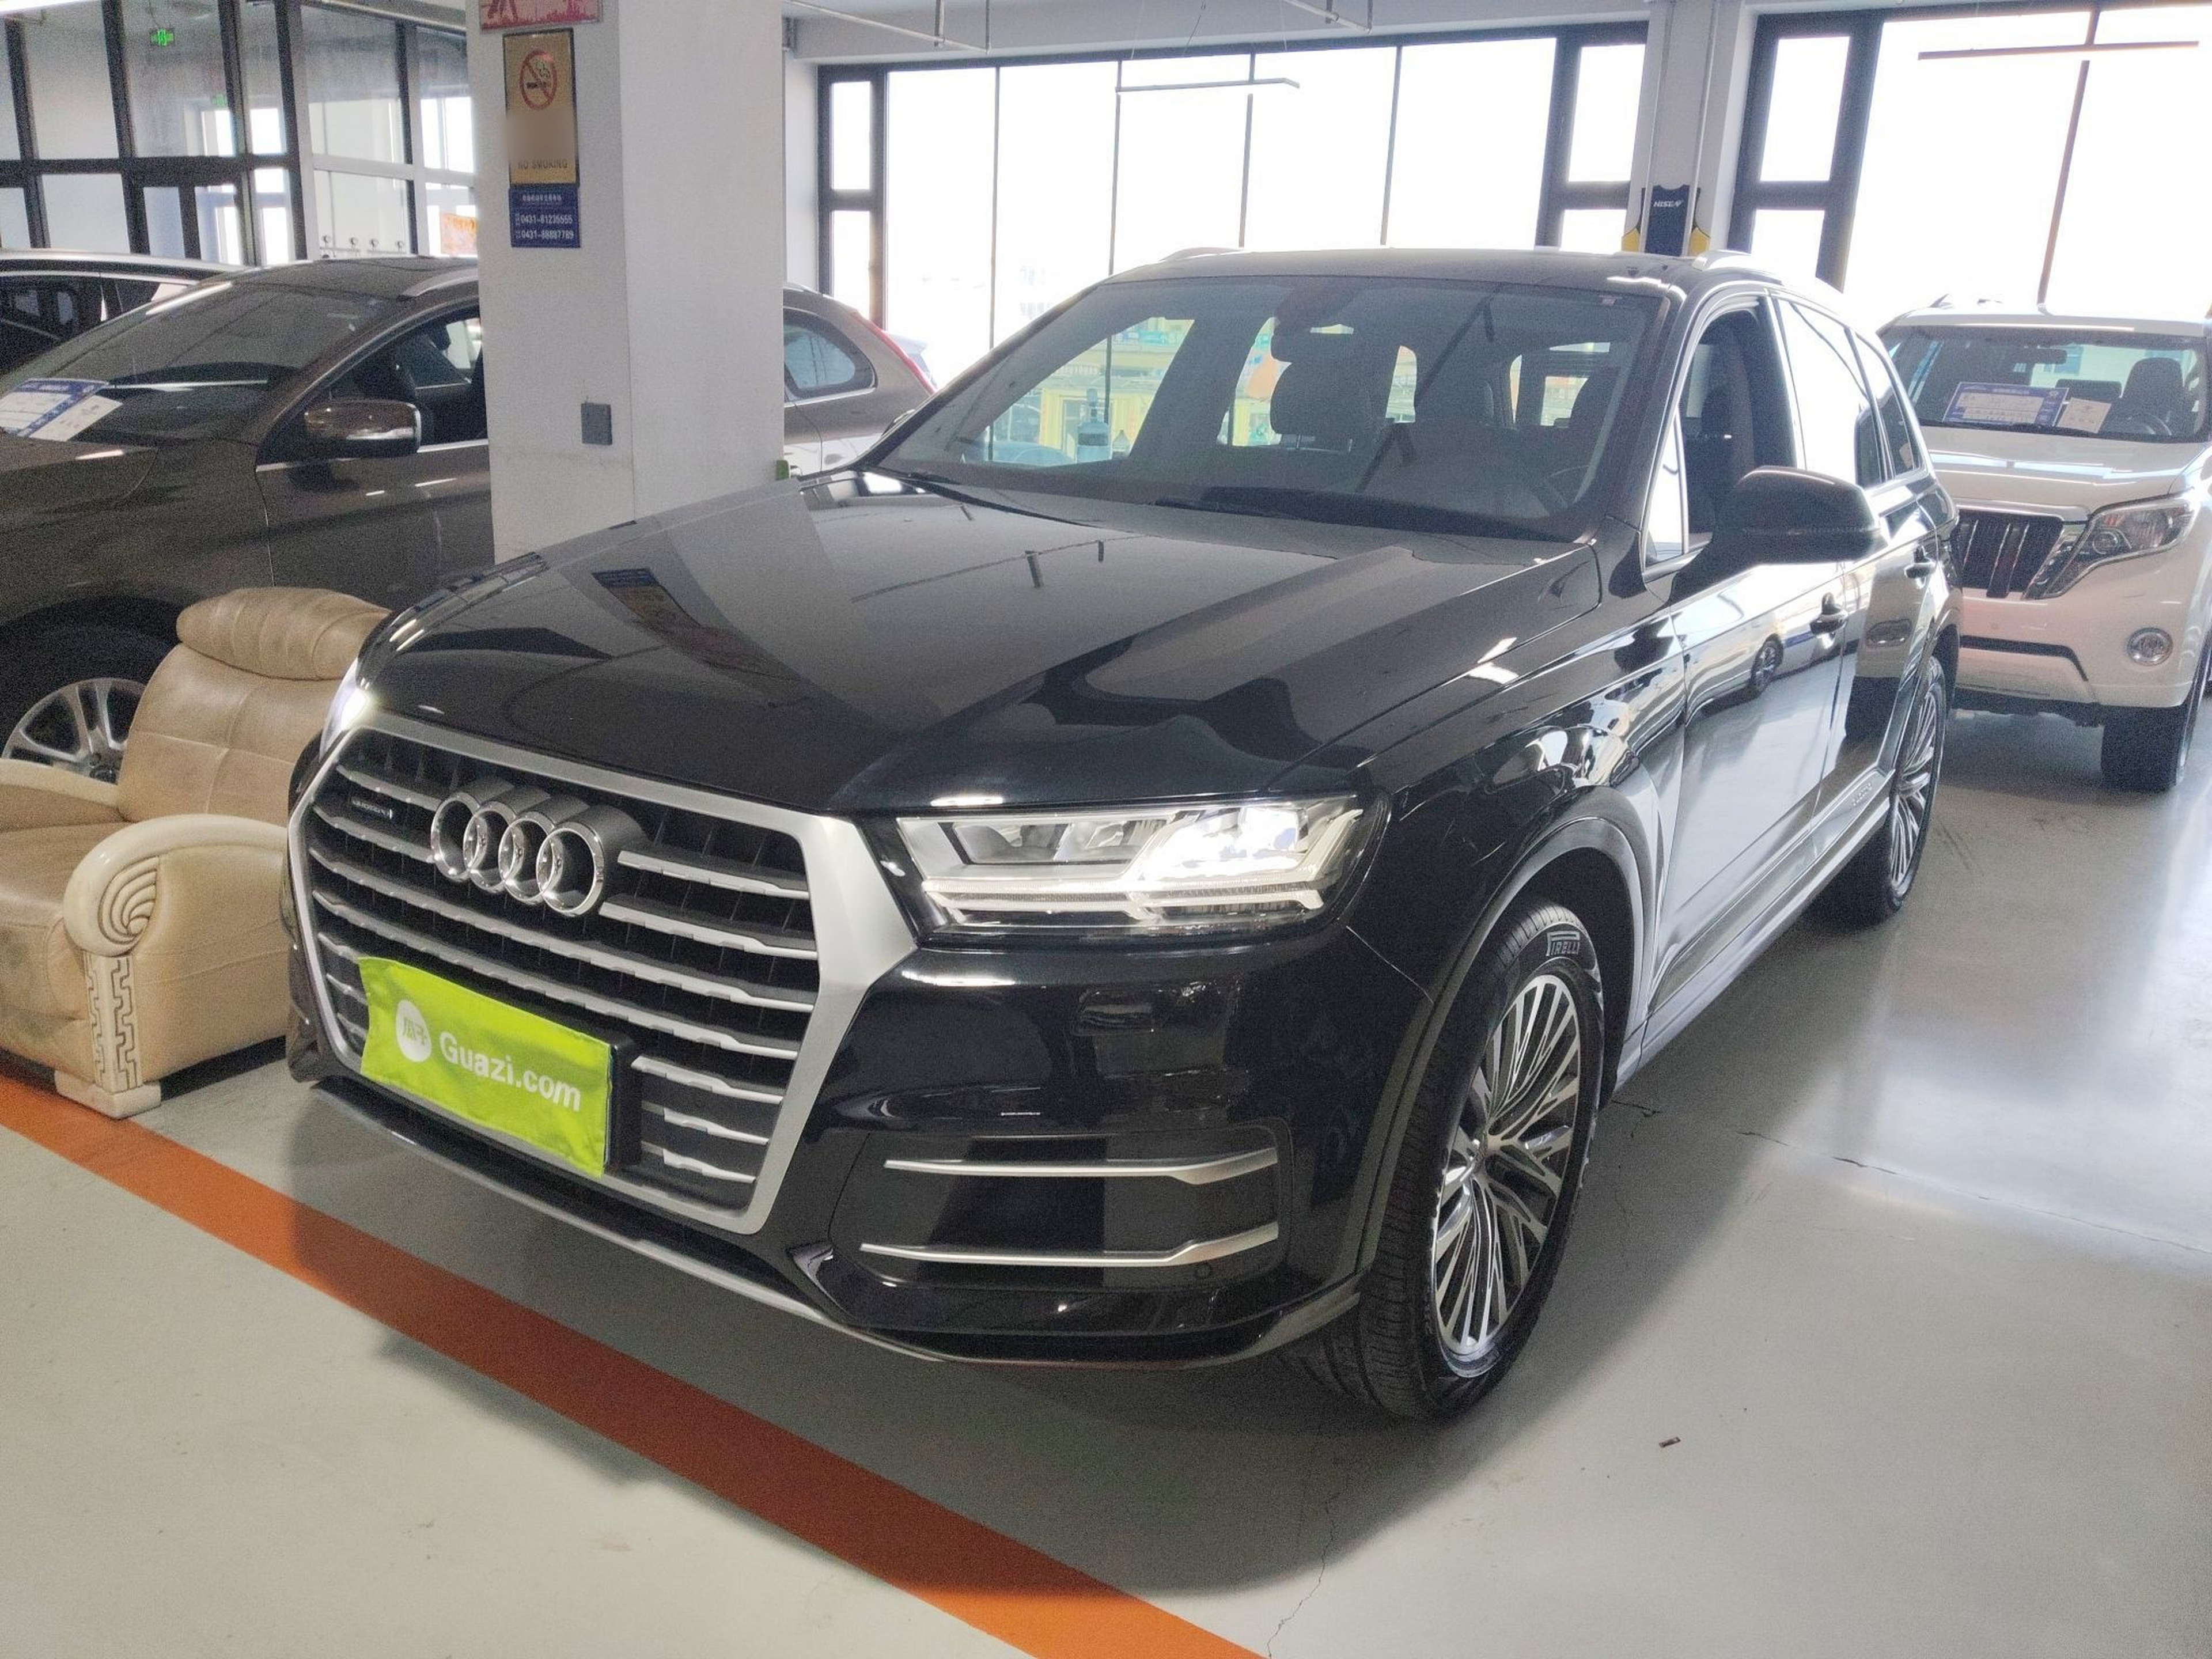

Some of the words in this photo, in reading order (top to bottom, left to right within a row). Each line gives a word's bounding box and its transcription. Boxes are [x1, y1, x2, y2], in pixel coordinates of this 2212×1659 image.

[532, 158, 567, 169] SMOKING
[1546, 930, 1580, 956] PIRELLI
[439, 1031, 581, 1112] Guazi.com
